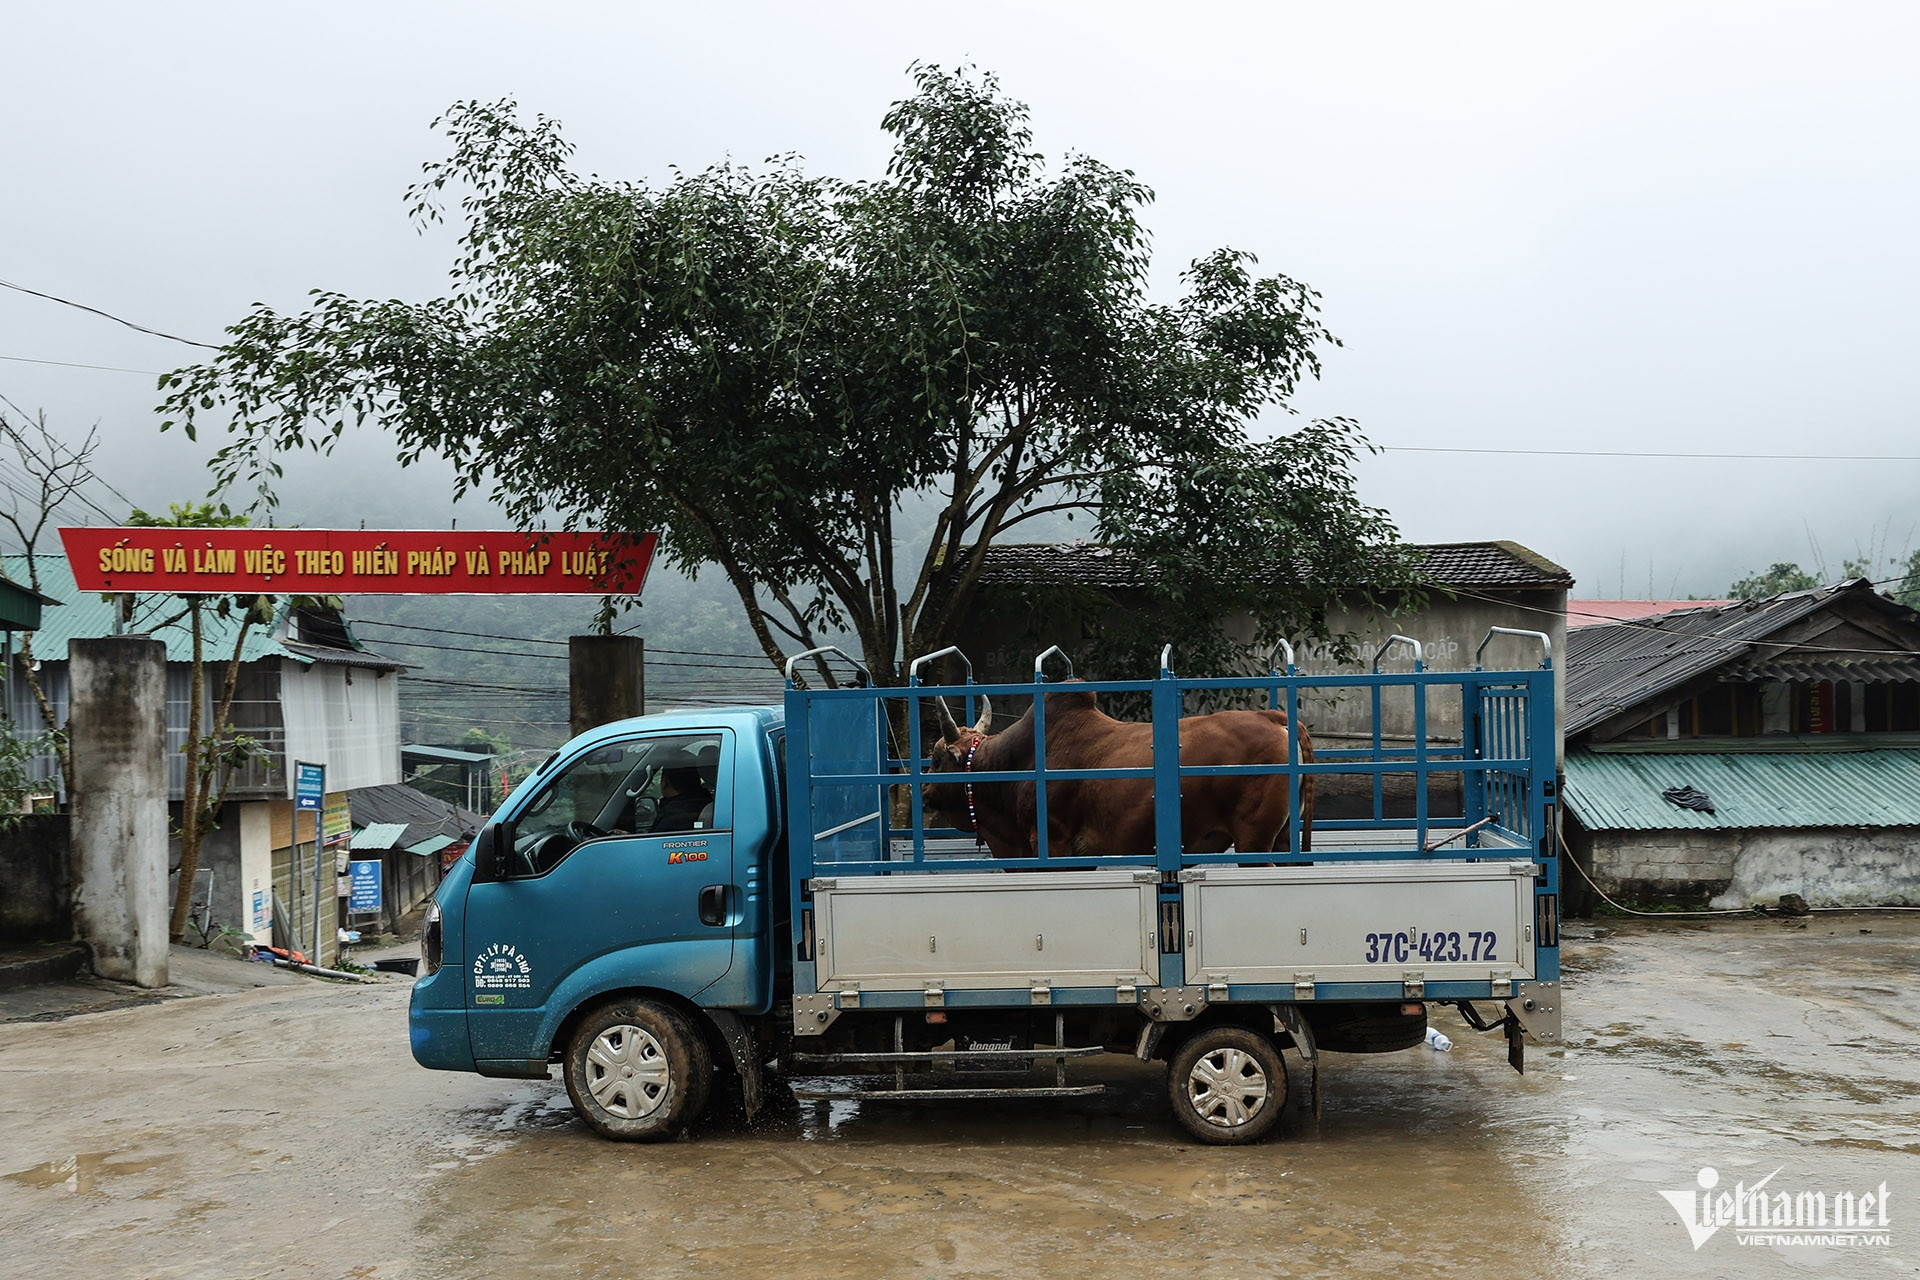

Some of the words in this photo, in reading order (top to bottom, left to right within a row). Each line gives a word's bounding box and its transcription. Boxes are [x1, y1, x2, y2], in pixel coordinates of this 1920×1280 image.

[98, 538, 155, 573] SỐNG
[162, 542, 188, 573] VÀ
[193, 542, 236, 574] LÀM
[243, 543, 286, 581] VIỆC
[295, 550, 345, 576] THEO
[352, 542, 399, 575] HIẾN
[407, 546, 457, 576] PHÁP
[465, 545, 490, 576] VÀ
[662, 840, 708, 849] FRONTIER
[668, 851, 708, 865] K100
[1365, 931, 1497, 963] 37C-423.72
